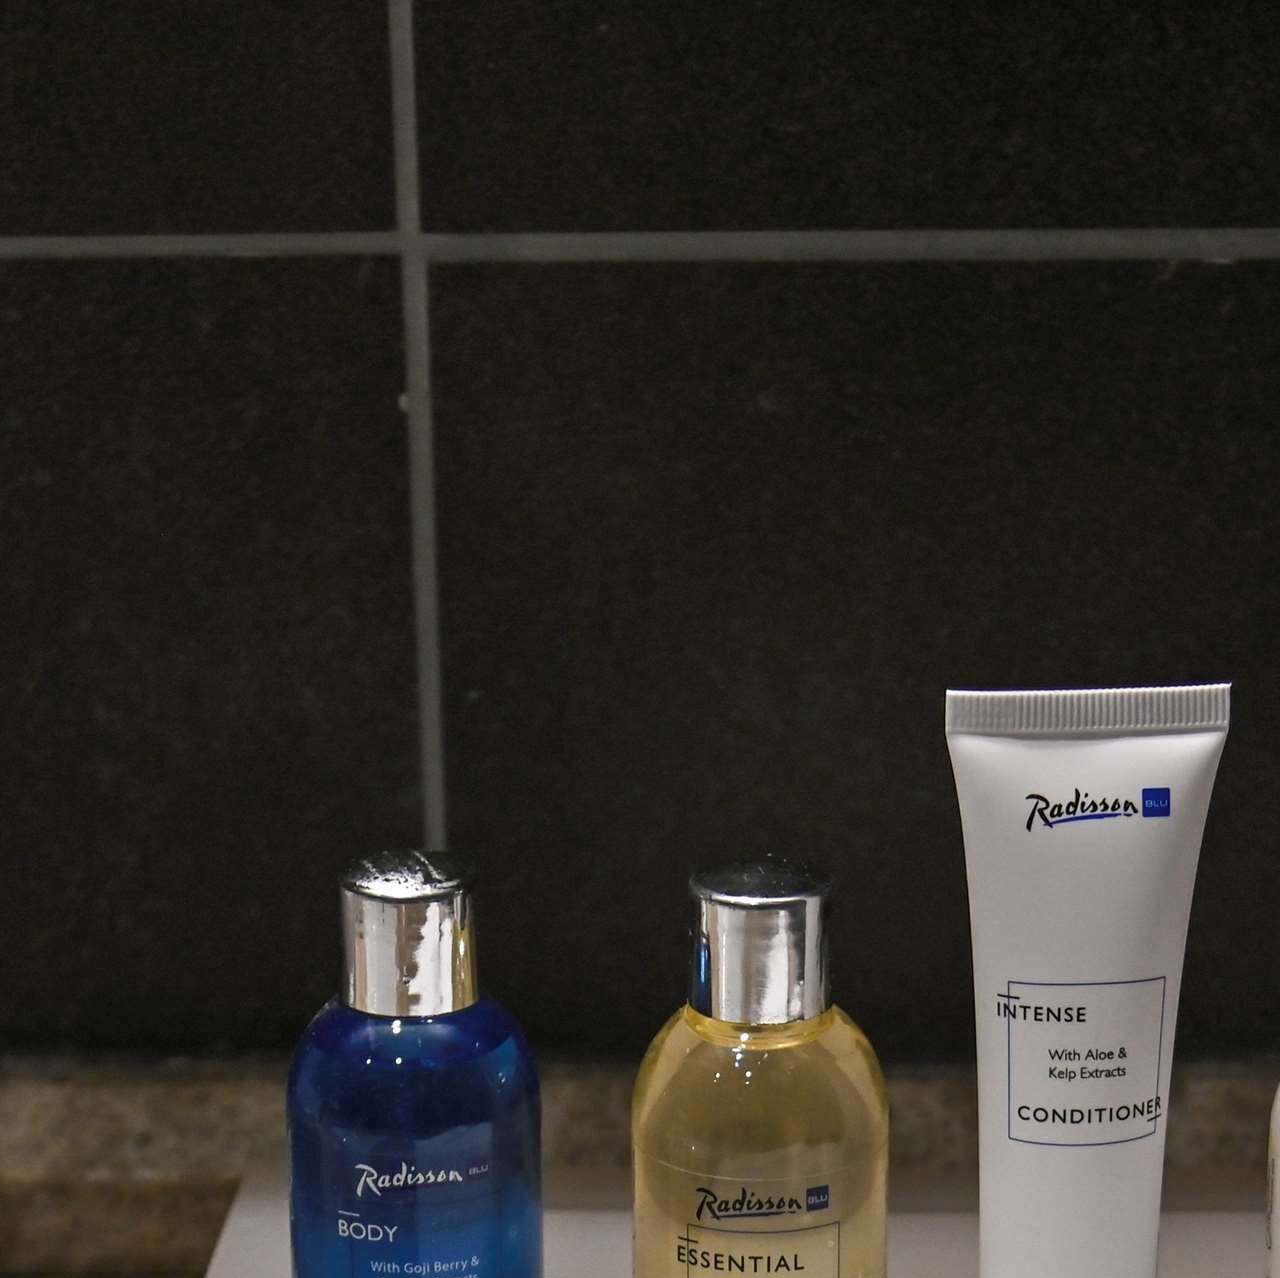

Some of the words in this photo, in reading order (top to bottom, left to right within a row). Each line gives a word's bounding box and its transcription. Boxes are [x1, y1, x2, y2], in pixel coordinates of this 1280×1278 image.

[1025, 788, 1139, 832] Radisson
[996, 1001, 1087, 1023] INTENSE
[1048, 1048, 1081, 1062] With
[1085, 1048, 1115, 1061] Aloe
[1117, 1047, 1128, 1059] &
[1048, 1066, 1077, 1082] Kelp
[1080, 1065, 1127, 1080] Extracts
[1017, 1096, 1162, 1125] CONDITIONER
[355, 1161, 463, 1198] Radisson
[696, 1187, 803, 1221] Radisson
[337, 1218, 399, 1243] BODY
[370, 1259, 401, 1274] With
[404, 1261, 431, 1276] Goji
[434, 1258, 468, 1273] Berry
[470, 1255, 480, 1266] &
[677, 1245, 805, 1273] ESSENTIAL
